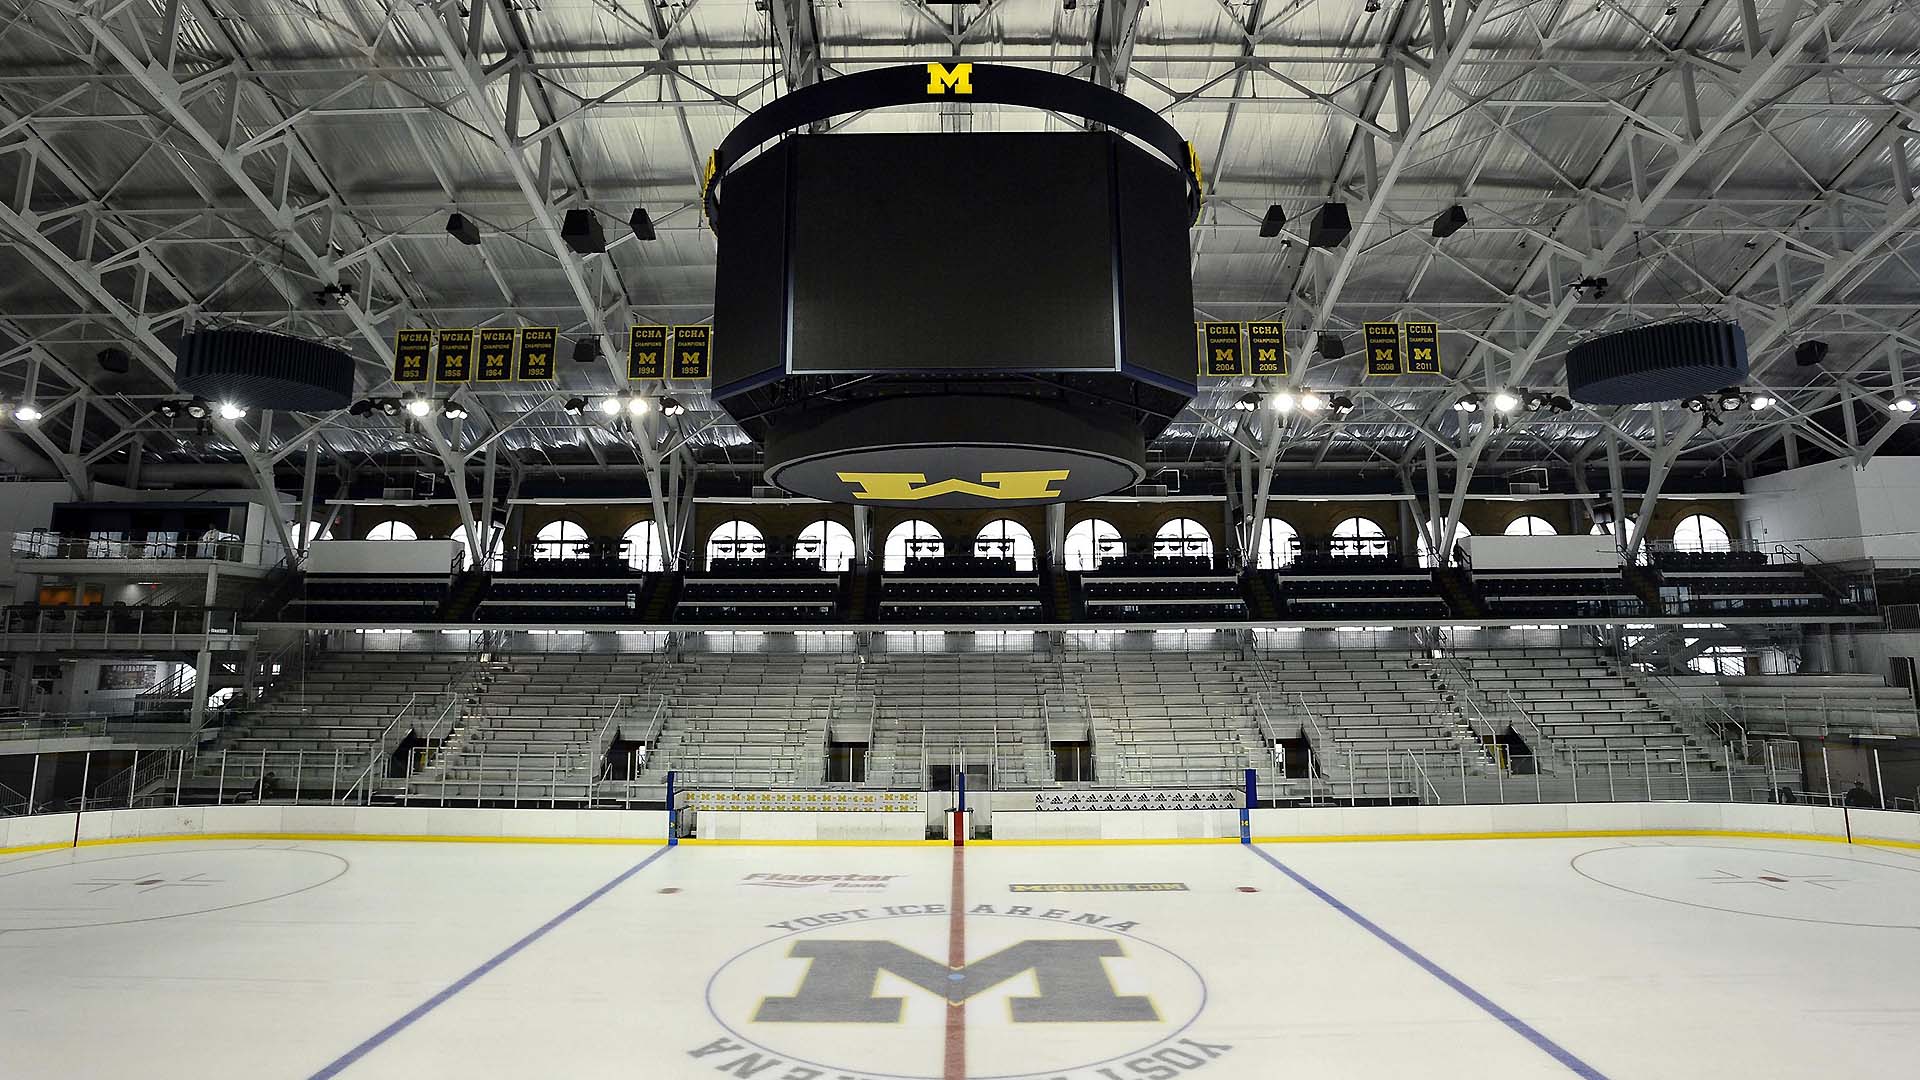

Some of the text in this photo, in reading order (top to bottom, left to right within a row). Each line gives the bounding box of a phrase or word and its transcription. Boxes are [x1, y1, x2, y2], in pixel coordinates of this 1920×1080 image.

[927, 63, 973, 93] M
[636, 330, 662, 338] CCHA
[679, 330, 705, 338] CCHA
[1210, 326, 1236, 334] CCHA
[1253, 326, 1279, 334] CCHA
[1410, 326, 1432, 334] CCHA
[400, 334, 428, 342] WCHA
[529, 354, 546, 365] M
[639, 352, 656, 364] M
[682, 352, 700, 364] M
[1215, 349, 1233, 361] M
[1259, 349, 1276, 361] M
[1376, 349, 1393, 360] M
[1414, 348, 1431, 360] M
[404, 356, 421, 367] M
[445, 355, 463, 367] M
[486, 354, 504, 366] M
[1416, 362, 1431, 370] 2011
[836, 470, 1070, 500] M
[742, 873, 903, 882] Flagstar
[766, 904, 1140, 932] YOST ICE ARENA
[749, 938, 1166, 1023] M
